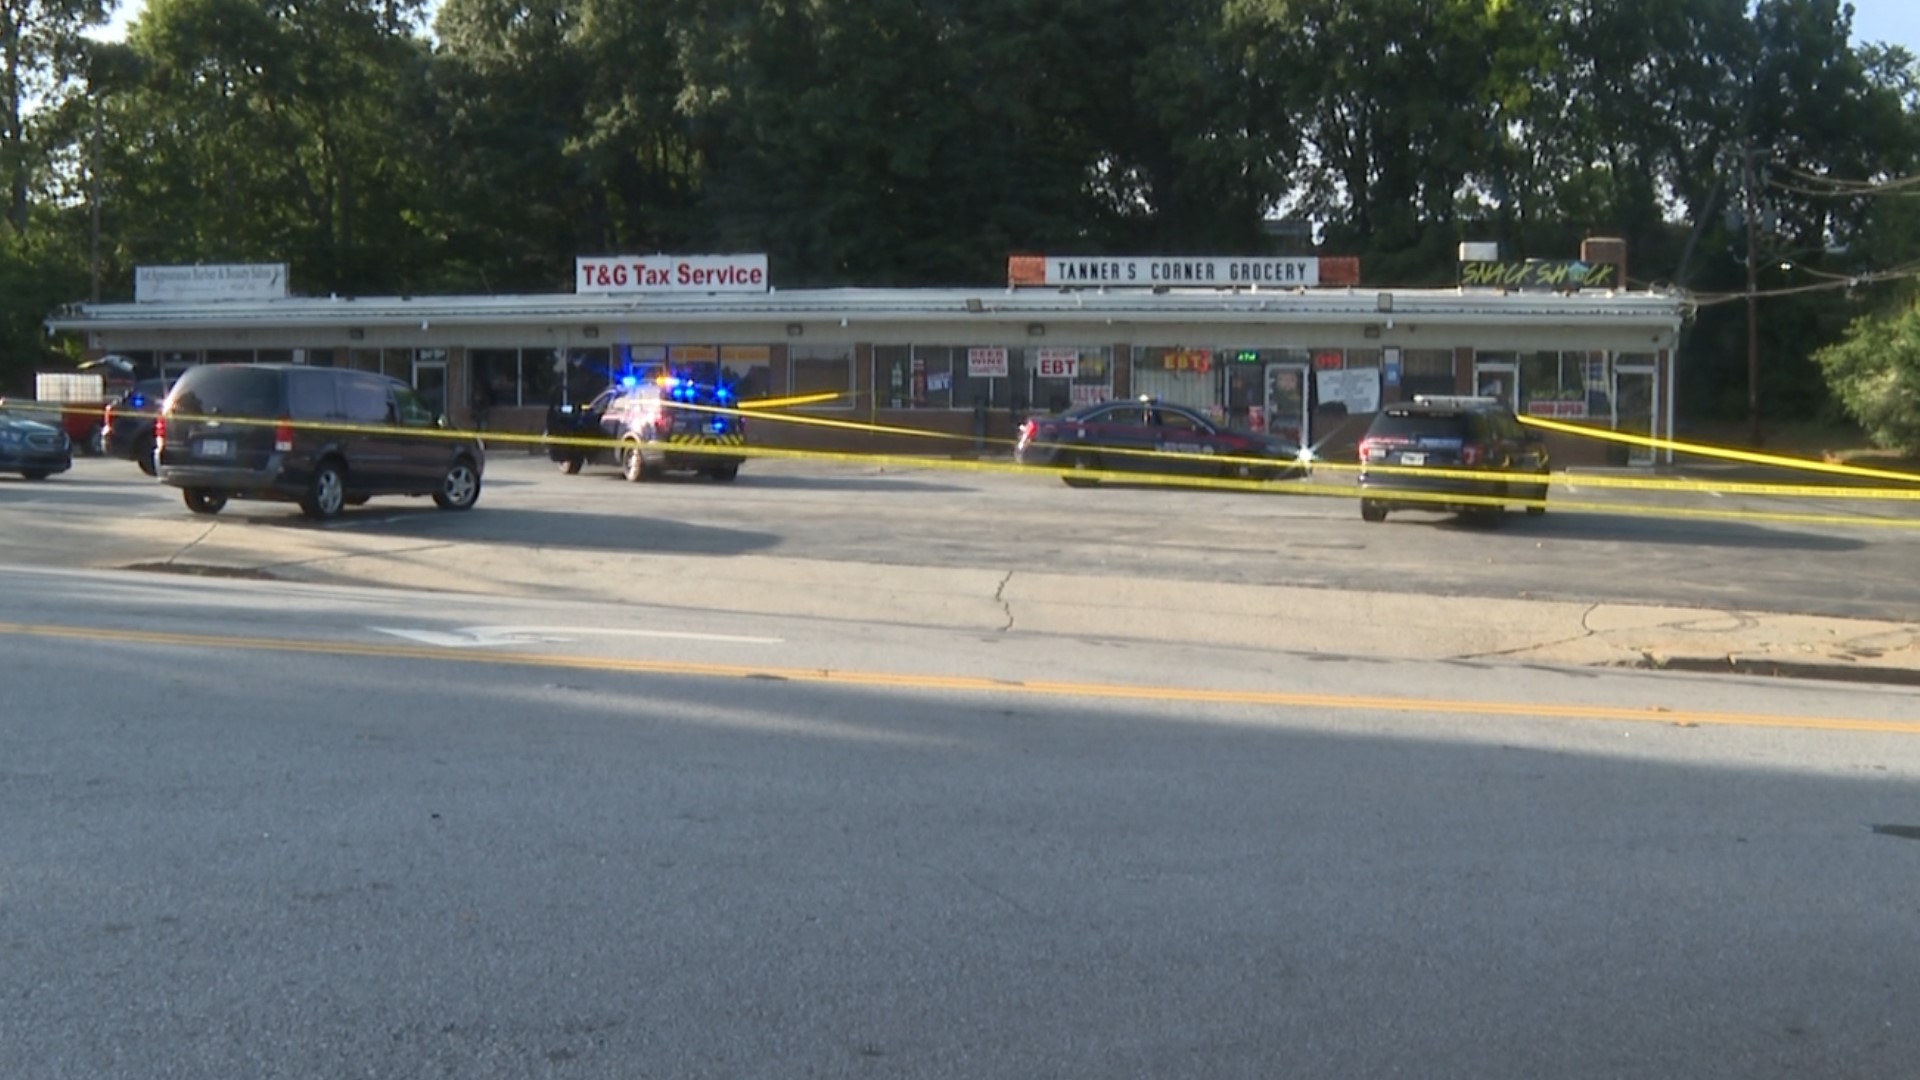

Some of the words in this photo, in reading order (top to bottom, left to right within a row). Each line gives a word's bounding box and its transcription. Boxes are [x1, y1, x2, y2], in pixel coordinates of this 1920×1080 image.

[582, 264, 627, 286] T&G
[633, 264, 670, 286] Tax
[677, 263, 762, 285] Service
[1058, 262, 1137, 280] TANNER'S
[1151, 262, 1215, 280] CORNER
[1230, 262, 1307, 281] GROCERY
[1461, 261, 1534, 285] SNACK
[971, 358, 1003, 366] WINE
[1040, 359, 1076, 375] EBT
[1163, 352, 1202, 369] EBT
